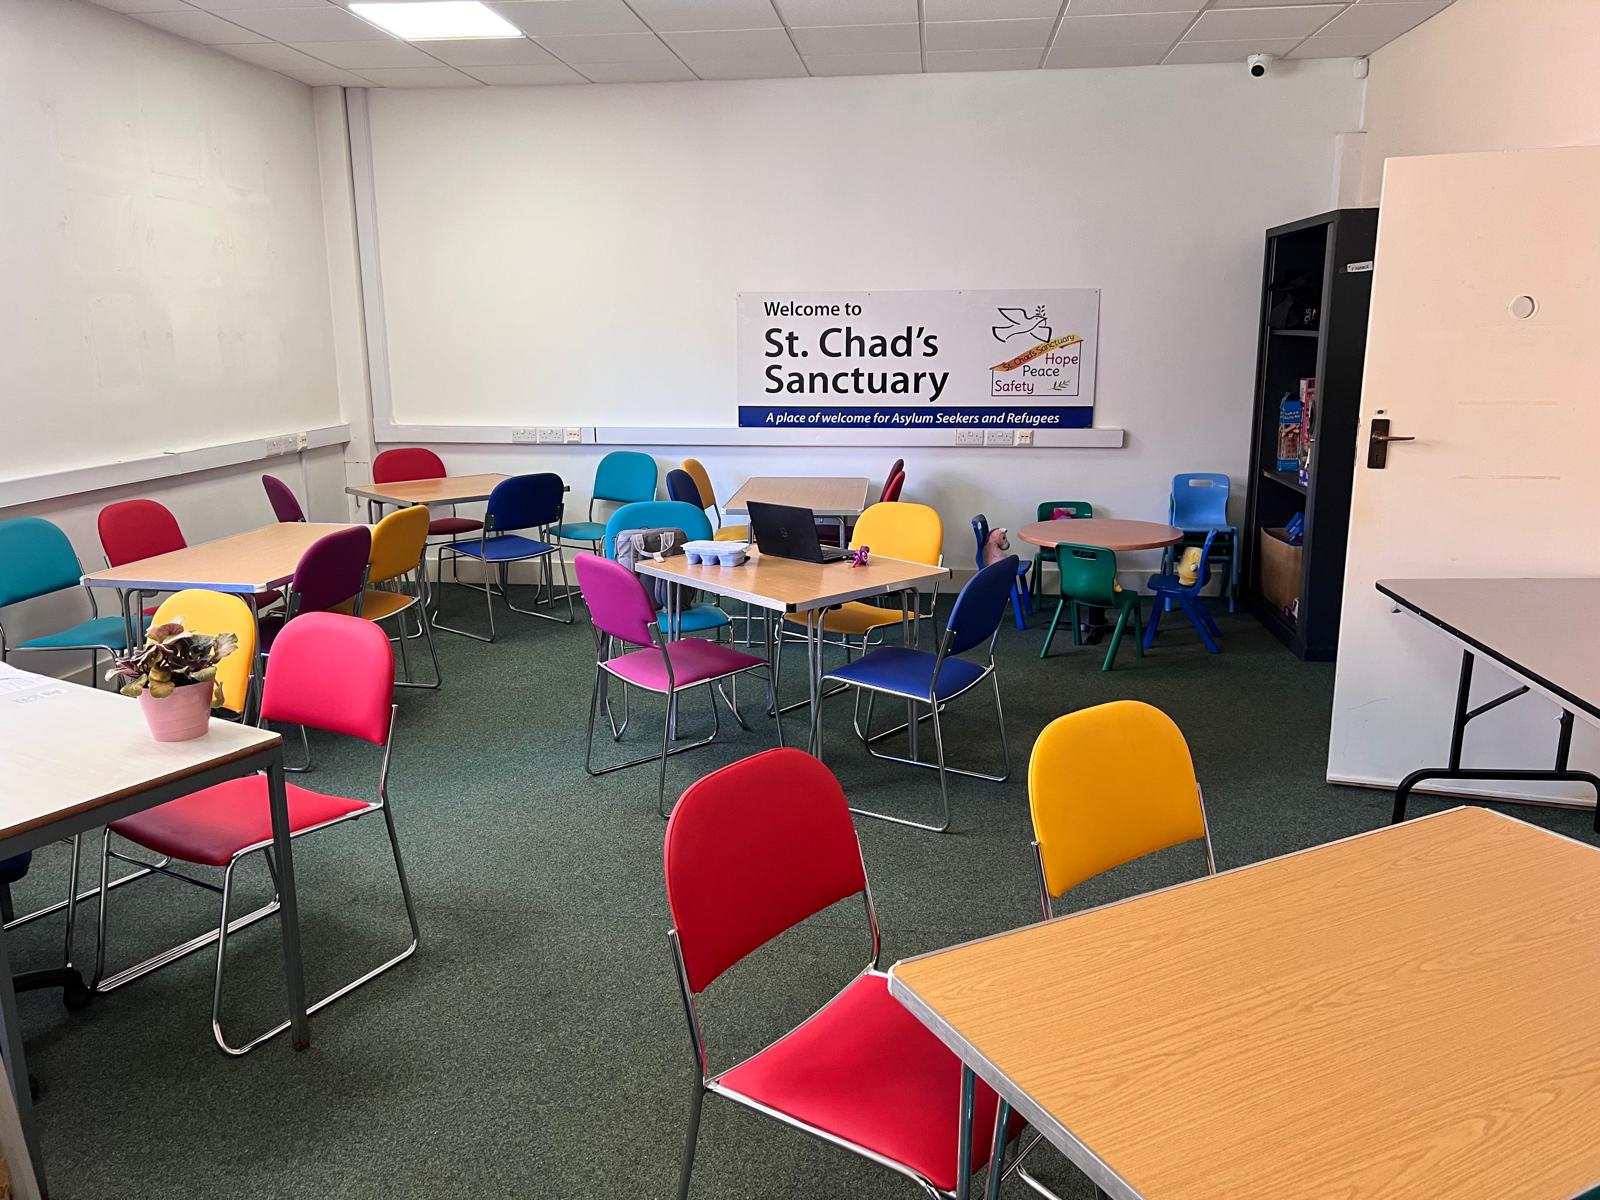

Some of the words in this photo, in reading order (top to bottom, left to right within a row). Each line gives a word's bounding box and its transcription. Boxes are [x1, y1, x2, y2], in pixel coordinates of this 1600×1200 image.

[764, 301, 840, 316] Welcome
[845, 302, 862, 316] to
[764, 328, 809, 358] St.
[819, 326, 939, 358] Chad’s
[1036, 335, 1075, 354] Sanctuary
[1045, 353, 1078, 367] Hope
[1022, 365, 1060, 377] Peace
[765, 364, 950, 403] Sanctuary
[994, 380, 1035, 394] Safety
[766, 412, 774, 423] A
[776, 412, 805, 425] place
[808, 412, 821, 424] of
[822, 412, 871, 424] welcome
[873, 412, 891, 424] for
[891, 412, 933, 426] Asylum
[936, 412, 979, 424] Seekers
[982, 412, 1005, 424] and
[1006, 412, 1060, 426] Refugees
